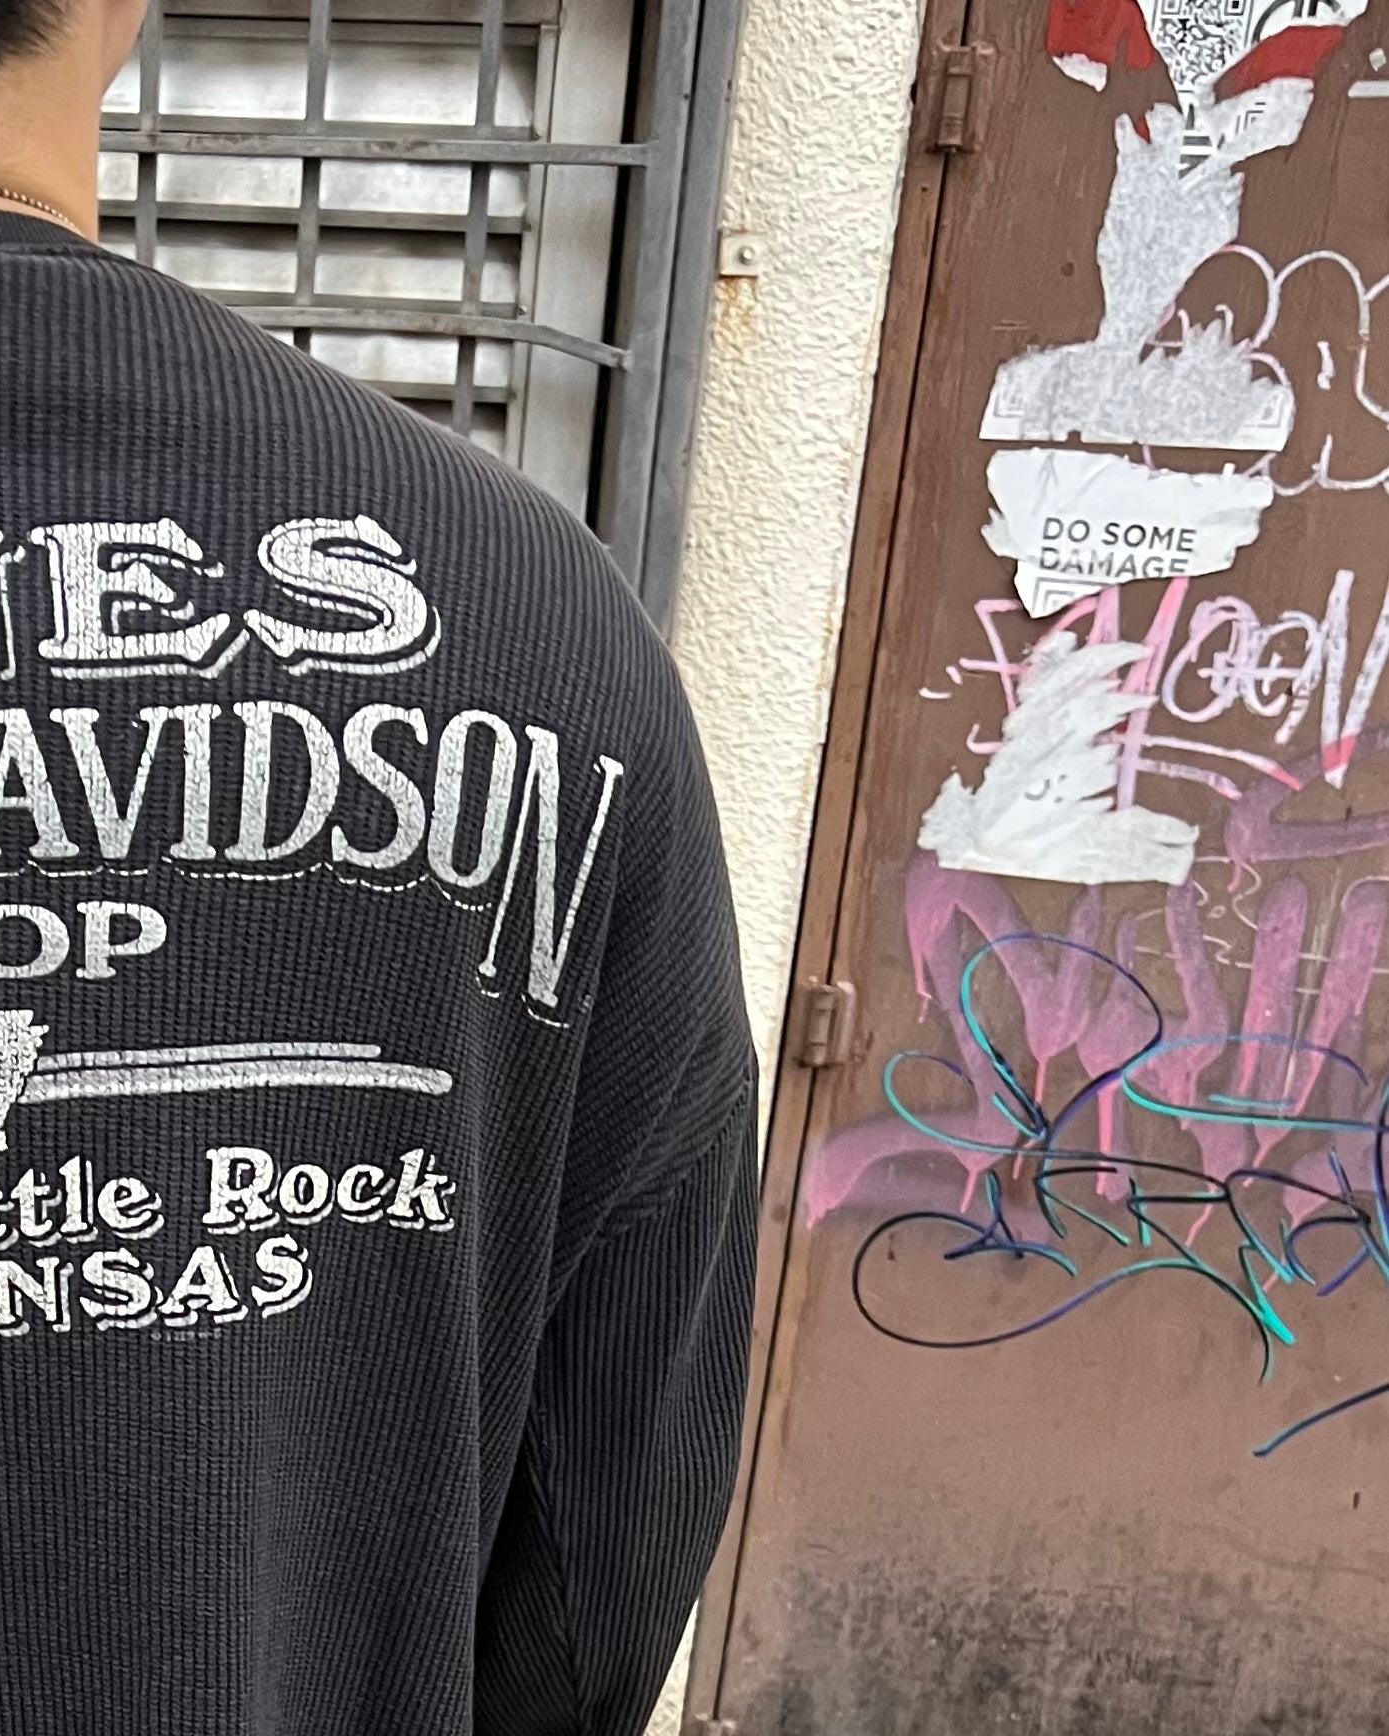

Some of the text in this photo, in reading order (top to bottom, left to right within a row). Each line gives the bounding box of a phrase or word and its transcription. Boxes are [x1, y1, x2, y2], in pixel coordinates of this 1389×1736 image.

[1042, 516, 1197, 553] DO SOME
[1039, 546, 1190, 579] DAMAGE
[205, 1147, 456, 1232] Rock
